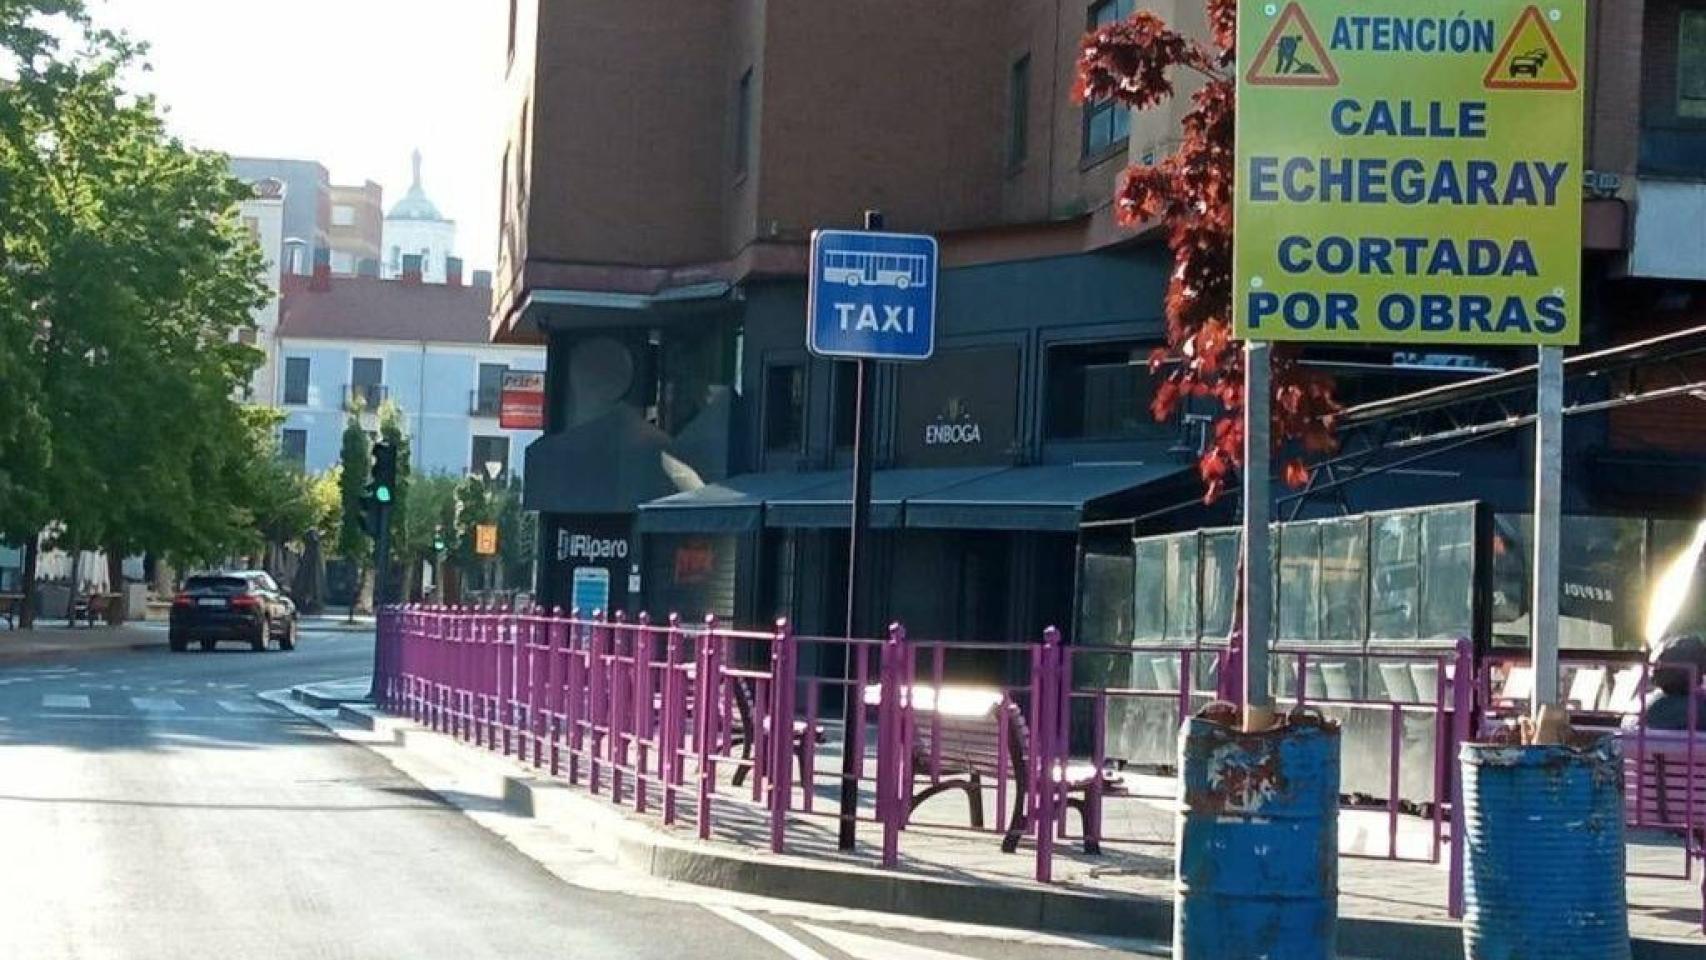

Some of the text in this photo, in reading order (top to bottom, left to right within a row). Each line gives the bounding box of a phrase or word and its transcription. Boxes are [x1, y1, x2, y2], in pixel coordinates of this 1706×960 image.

[1330, 10, 1494, 53] ATENCIÓN
[1331, 99, 1487, 138] CALLE
[1249, 156, 1568, 207] ECHEGARAY
[1277, 235, 1539, 277] CORTADA
[834, 303, 915, 333] TAXI
[1247, 292, 1567, 334] POR OBRAS
[925, 424, 981, 444] ENBOGA
